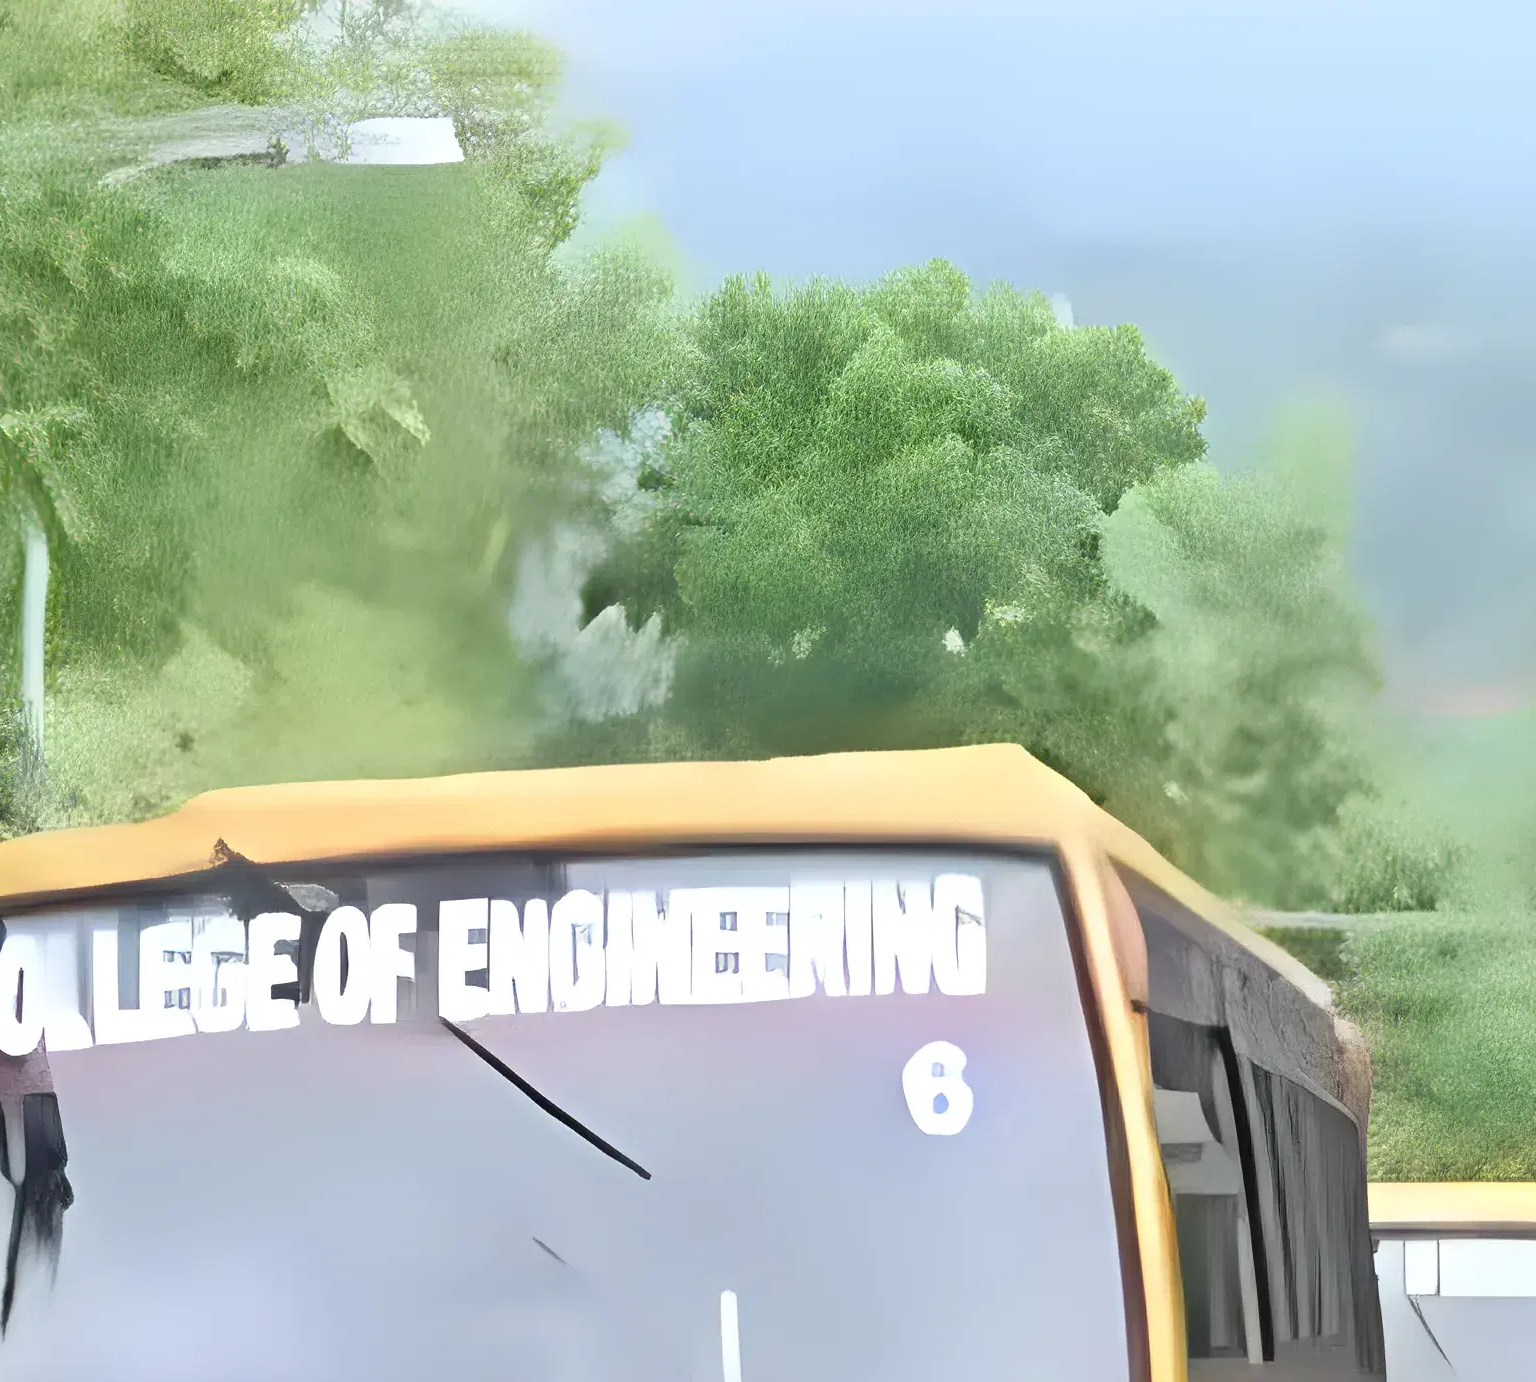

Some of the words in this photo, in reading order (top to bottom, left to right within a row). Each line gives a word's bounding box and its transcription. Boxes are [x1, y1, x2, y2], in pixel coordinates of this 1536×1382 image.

[314, 903, 417, 1025] OF
[438, 874, 987, 1022] ENGINEERING
[902, 1040, 974, 1136] 6
